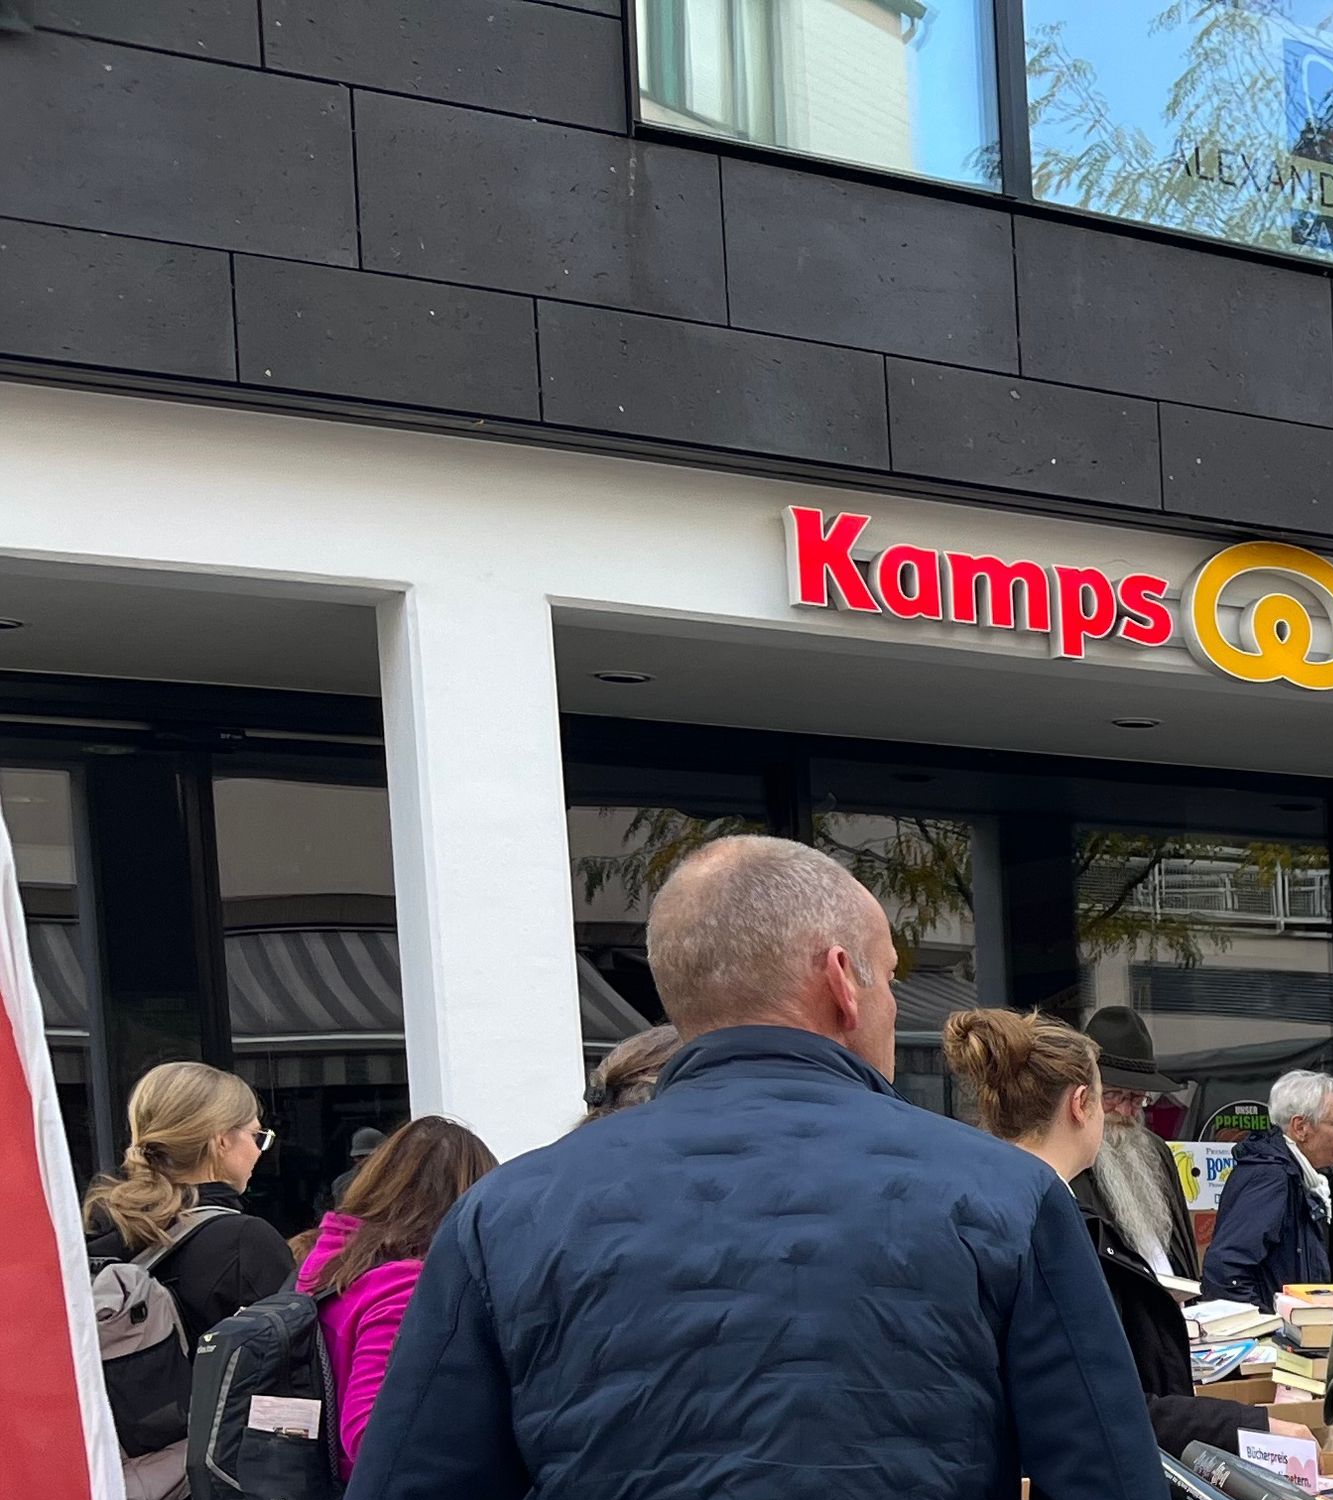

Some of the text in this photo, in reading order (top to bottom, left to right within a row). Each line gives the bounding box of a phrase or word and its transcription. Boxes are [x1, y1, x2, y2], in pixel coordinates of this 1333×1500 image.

[785, 504, 1173, 659] Kamps
[1234, 1105, 1258, 1115] UNSER
[1246, 1446, 1289, 1465] Bücherpreis
